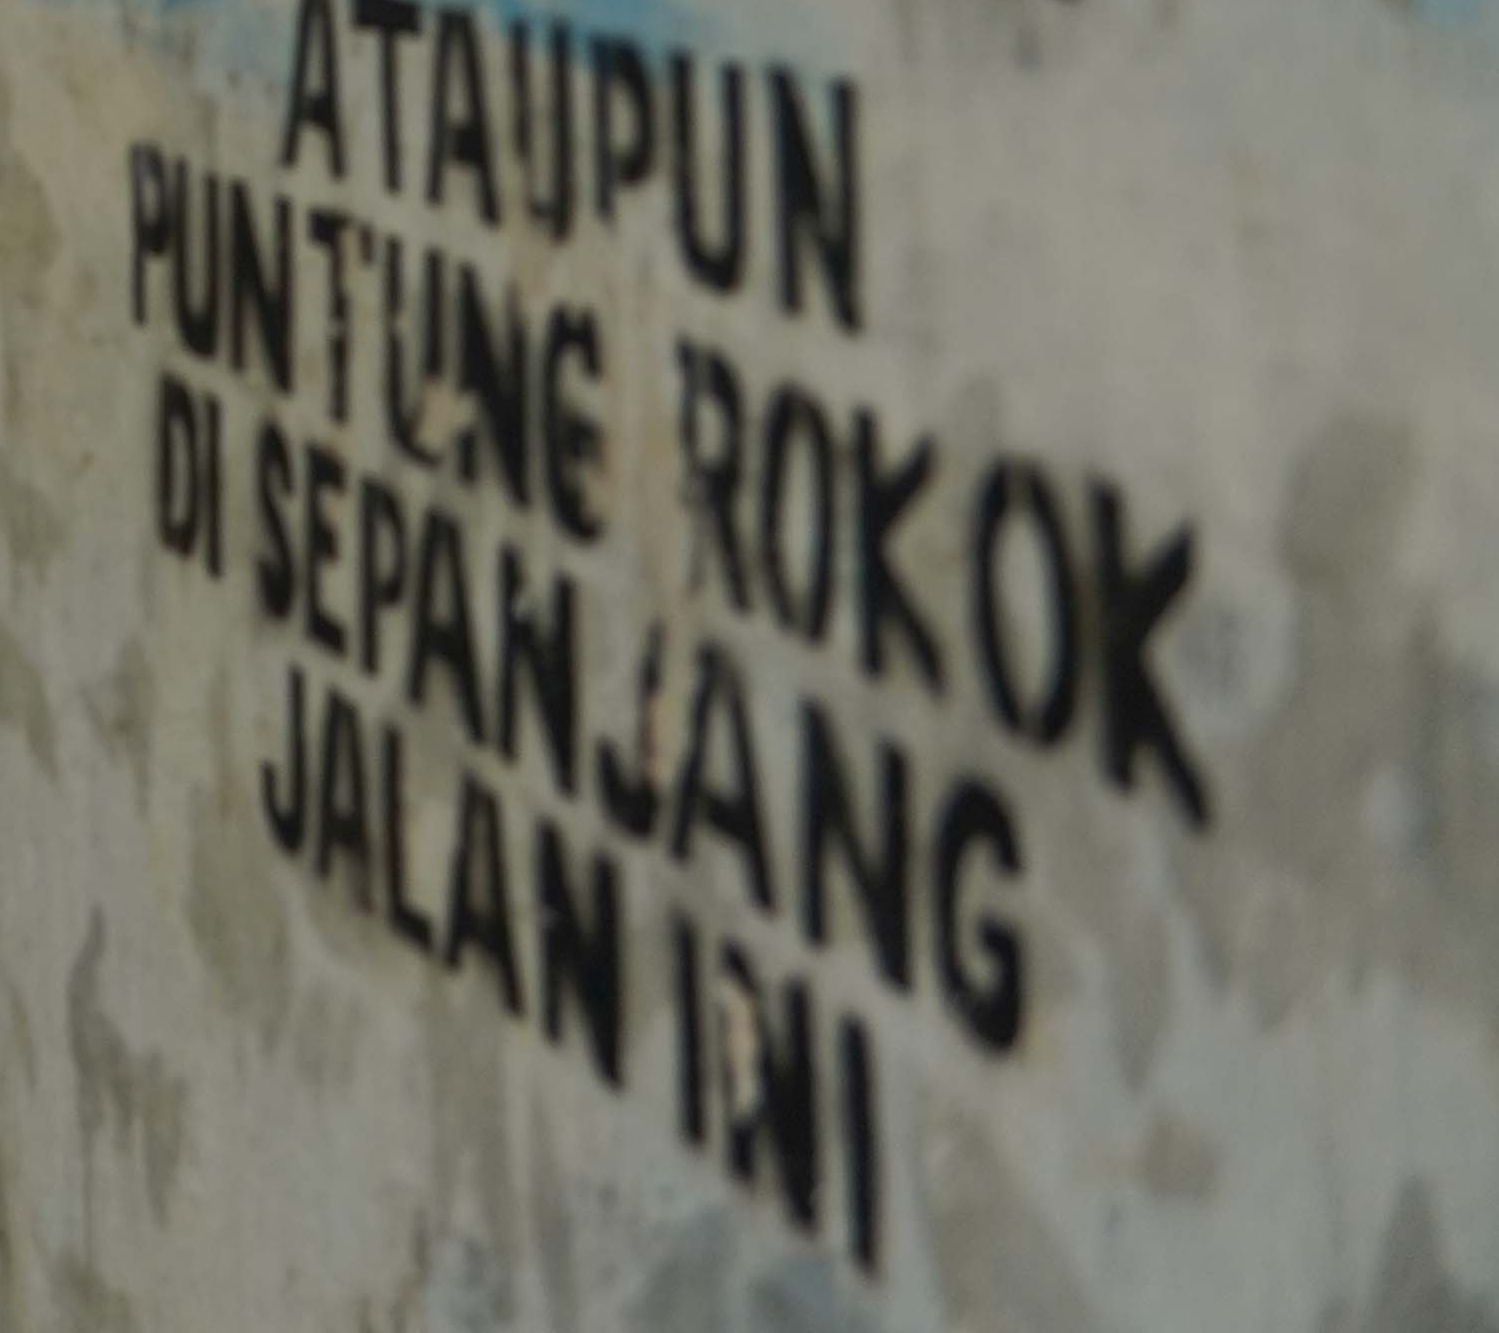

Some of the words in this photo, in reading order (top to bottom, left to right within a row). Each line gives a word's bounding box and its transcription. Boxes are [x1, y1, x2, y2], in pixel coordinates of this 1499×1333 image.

[131, 143, 605, 543] PUNTUNG
[677, 333, 1214, 839] ROKOK
[156, 370, 223, 581] DI
[254, 420, 1024, 1061] SEPANJANG
[264, 664, 626, 1093] JALAN
[671, 908, 882, 1281] INI
